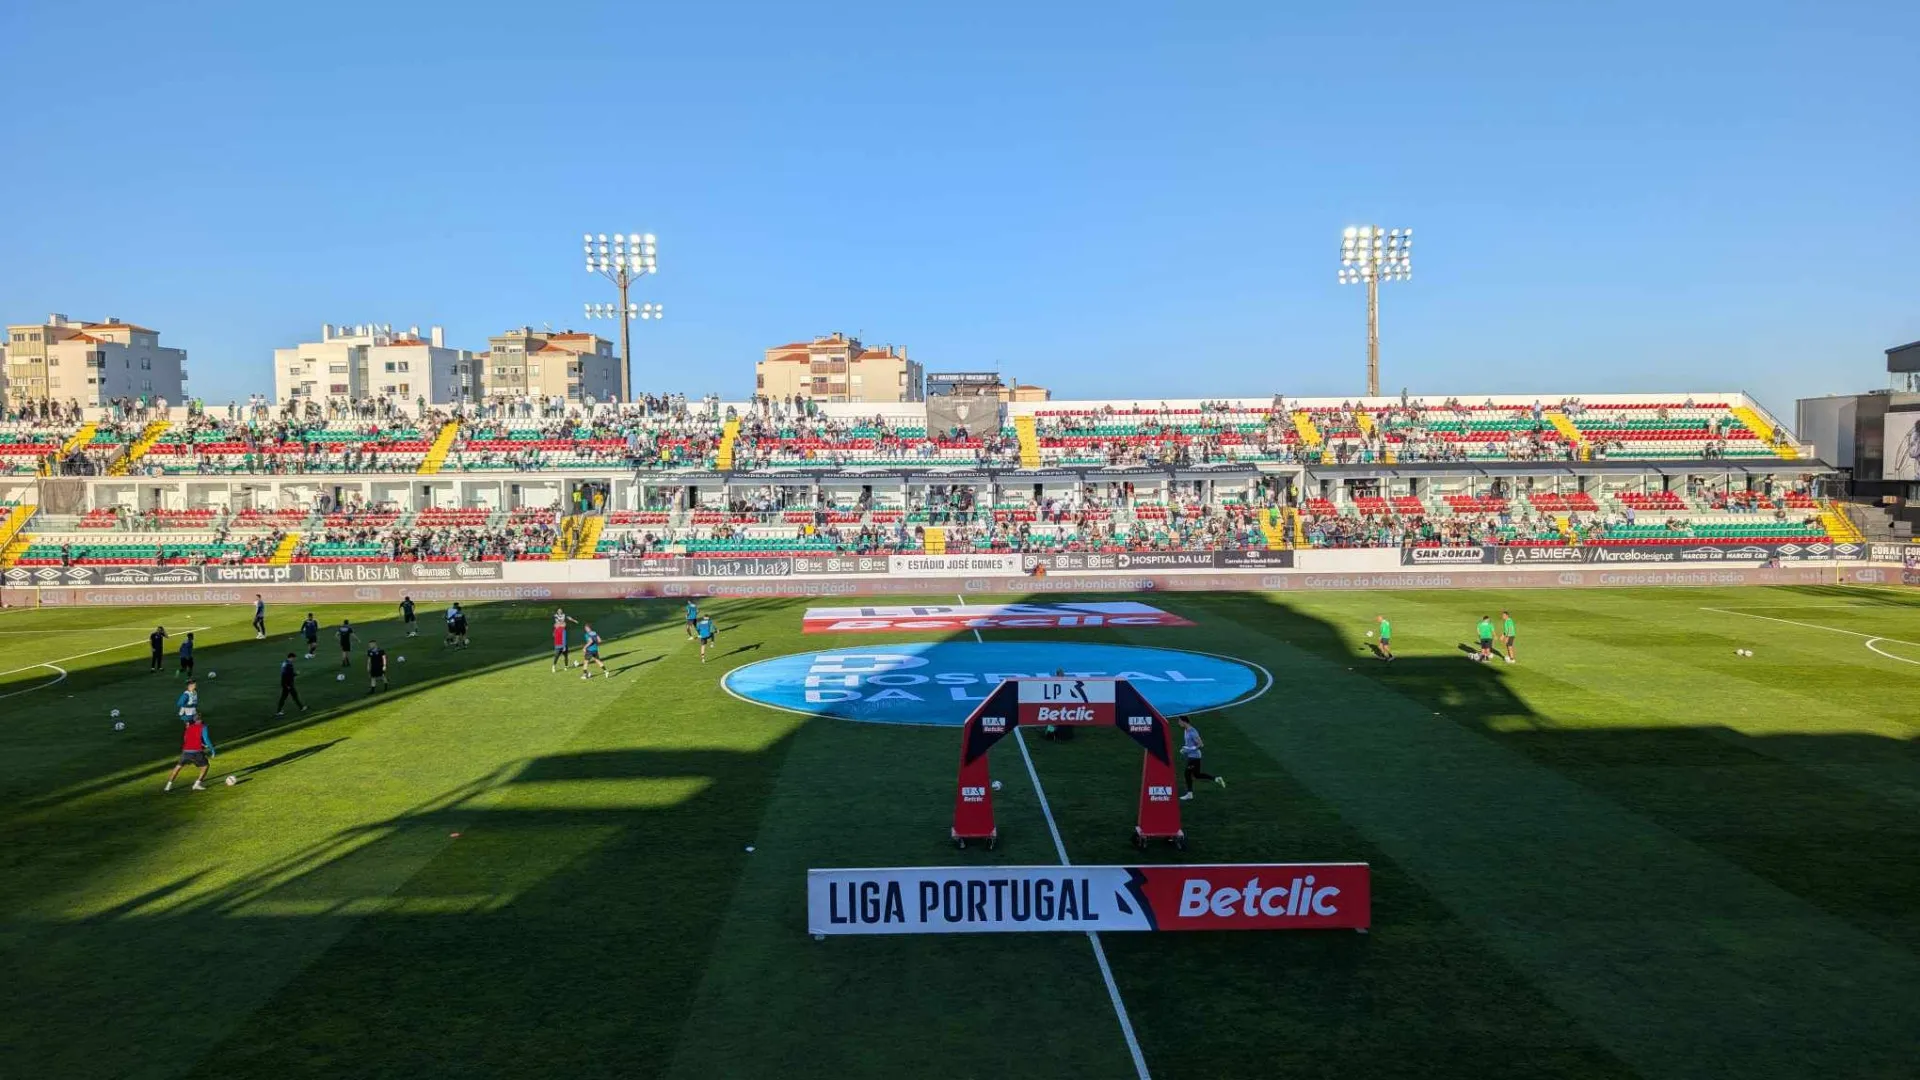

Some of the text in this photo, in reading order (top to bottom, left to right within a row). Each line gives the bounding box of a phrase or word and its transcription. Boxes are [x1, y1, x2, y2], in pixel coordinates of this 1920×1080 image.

[1515, 548, 1582, 559] A SMEFA
[1871, 546, 1902, 555] CORAL
[908, 558, 1003, 570] ESTÁDIO JOSÉ GOMES
[1132, 554, 1212, 564] HOSPITAL DA LUZ
[217, 565, 292, 582] renata.pt
[336, 565, 353, 580] AIR
[382, 564, 400, 579] AIR
[1305, 576, 1350, 587] Correio
[1353, 576, 1369, 586] da
[1600, 573, 1645, 584] Correio
[1649, 572, 1662, 584] da
[708, 584, 753, 594] Correio
[757, 584, 772, 594] da
[1008, 579, 1053, 590] Correio
[1055, 579, 1071, 589] da
[85, 591, 133, 602] Correio
[141, 590, 153, 602] da
[399, 587, 446, 598] Correio
[448, 587, 465, 598] da
[827, 615, 1161, 630] Betclic
[805, 688, 925, 703] DA
[1044, 684, 1062, 700] LP
[1038, 706, 1095, 721] Betclic
[829, 878, 1099, 924] LIGA PORTUGAL
[1178, 875, 1341, 917] Betclic
